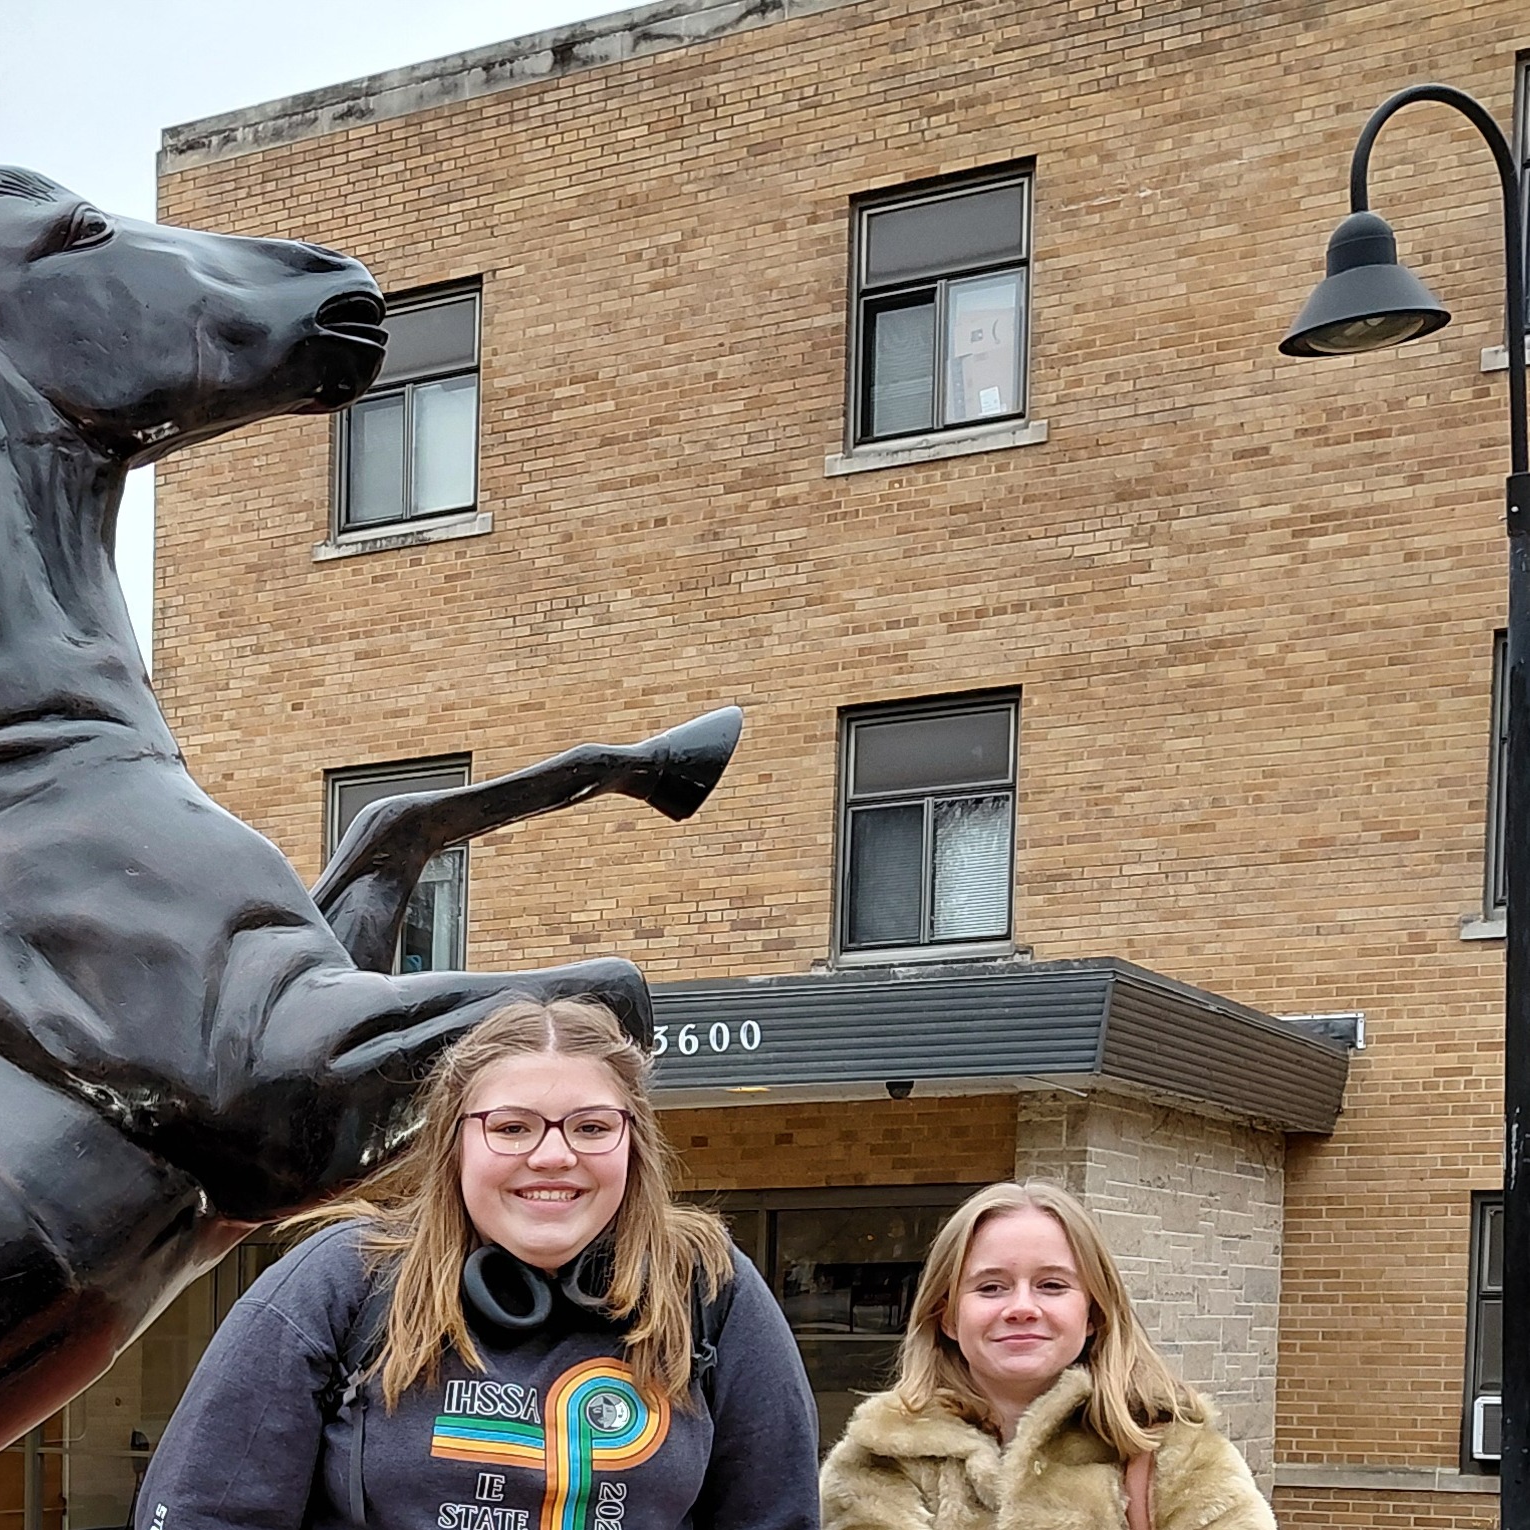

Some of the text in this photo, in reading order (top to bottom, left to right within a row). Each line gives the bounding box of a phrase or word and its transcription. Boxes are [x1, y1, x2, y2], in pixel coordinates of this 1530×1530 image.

[652, 1019, 762, 1056] 3600
[443, 1379, 542, 1425] IHSSA
[474, 1472, 506, 1502] IE
